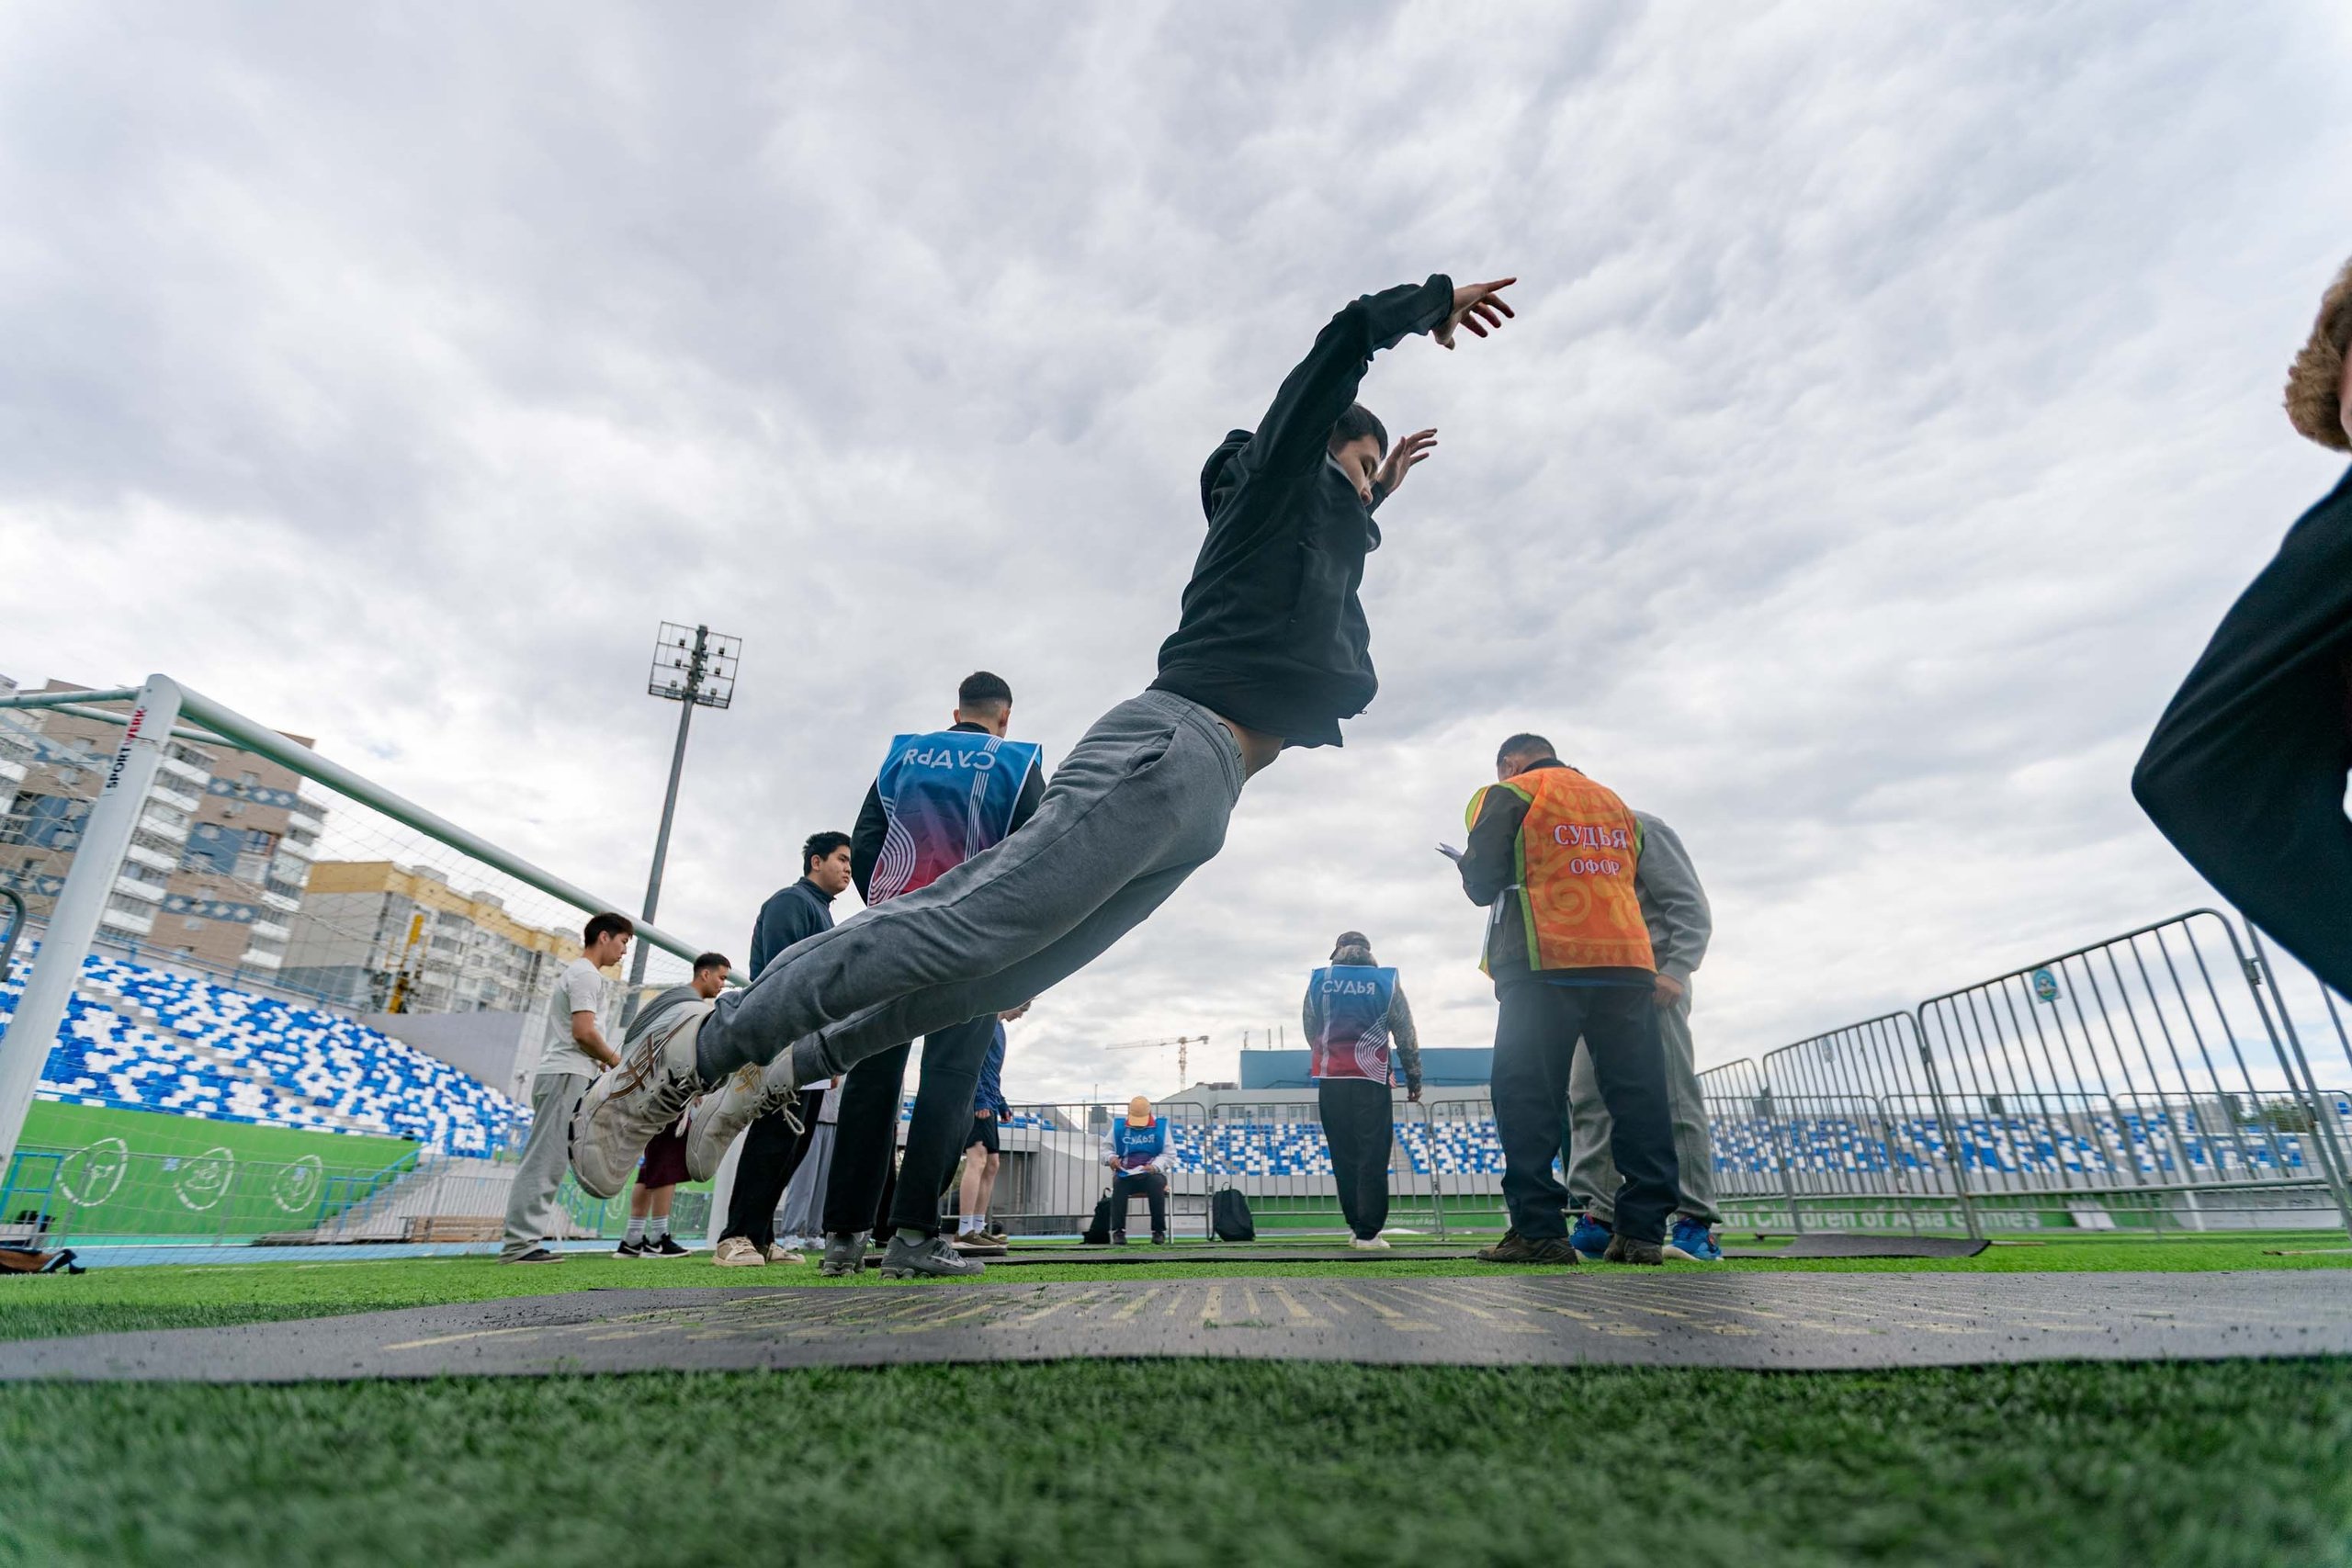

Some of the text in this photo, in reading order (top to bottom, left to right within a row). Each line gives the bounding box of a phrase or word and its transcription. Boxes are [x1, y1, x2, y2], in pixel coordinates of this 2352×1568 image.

[1554, 824, 1628, 851] СУДЬЯ
[1570, 858, 1620, 875] ОФОР
[1322, 980, 1375, 996] СУДЬЯ
[1122, 1134, 1155, 1145] СУДЬЯ
[1753, 1204, 1856, 1228] Chidren
[1860, 1203, 1888, 1227] of
